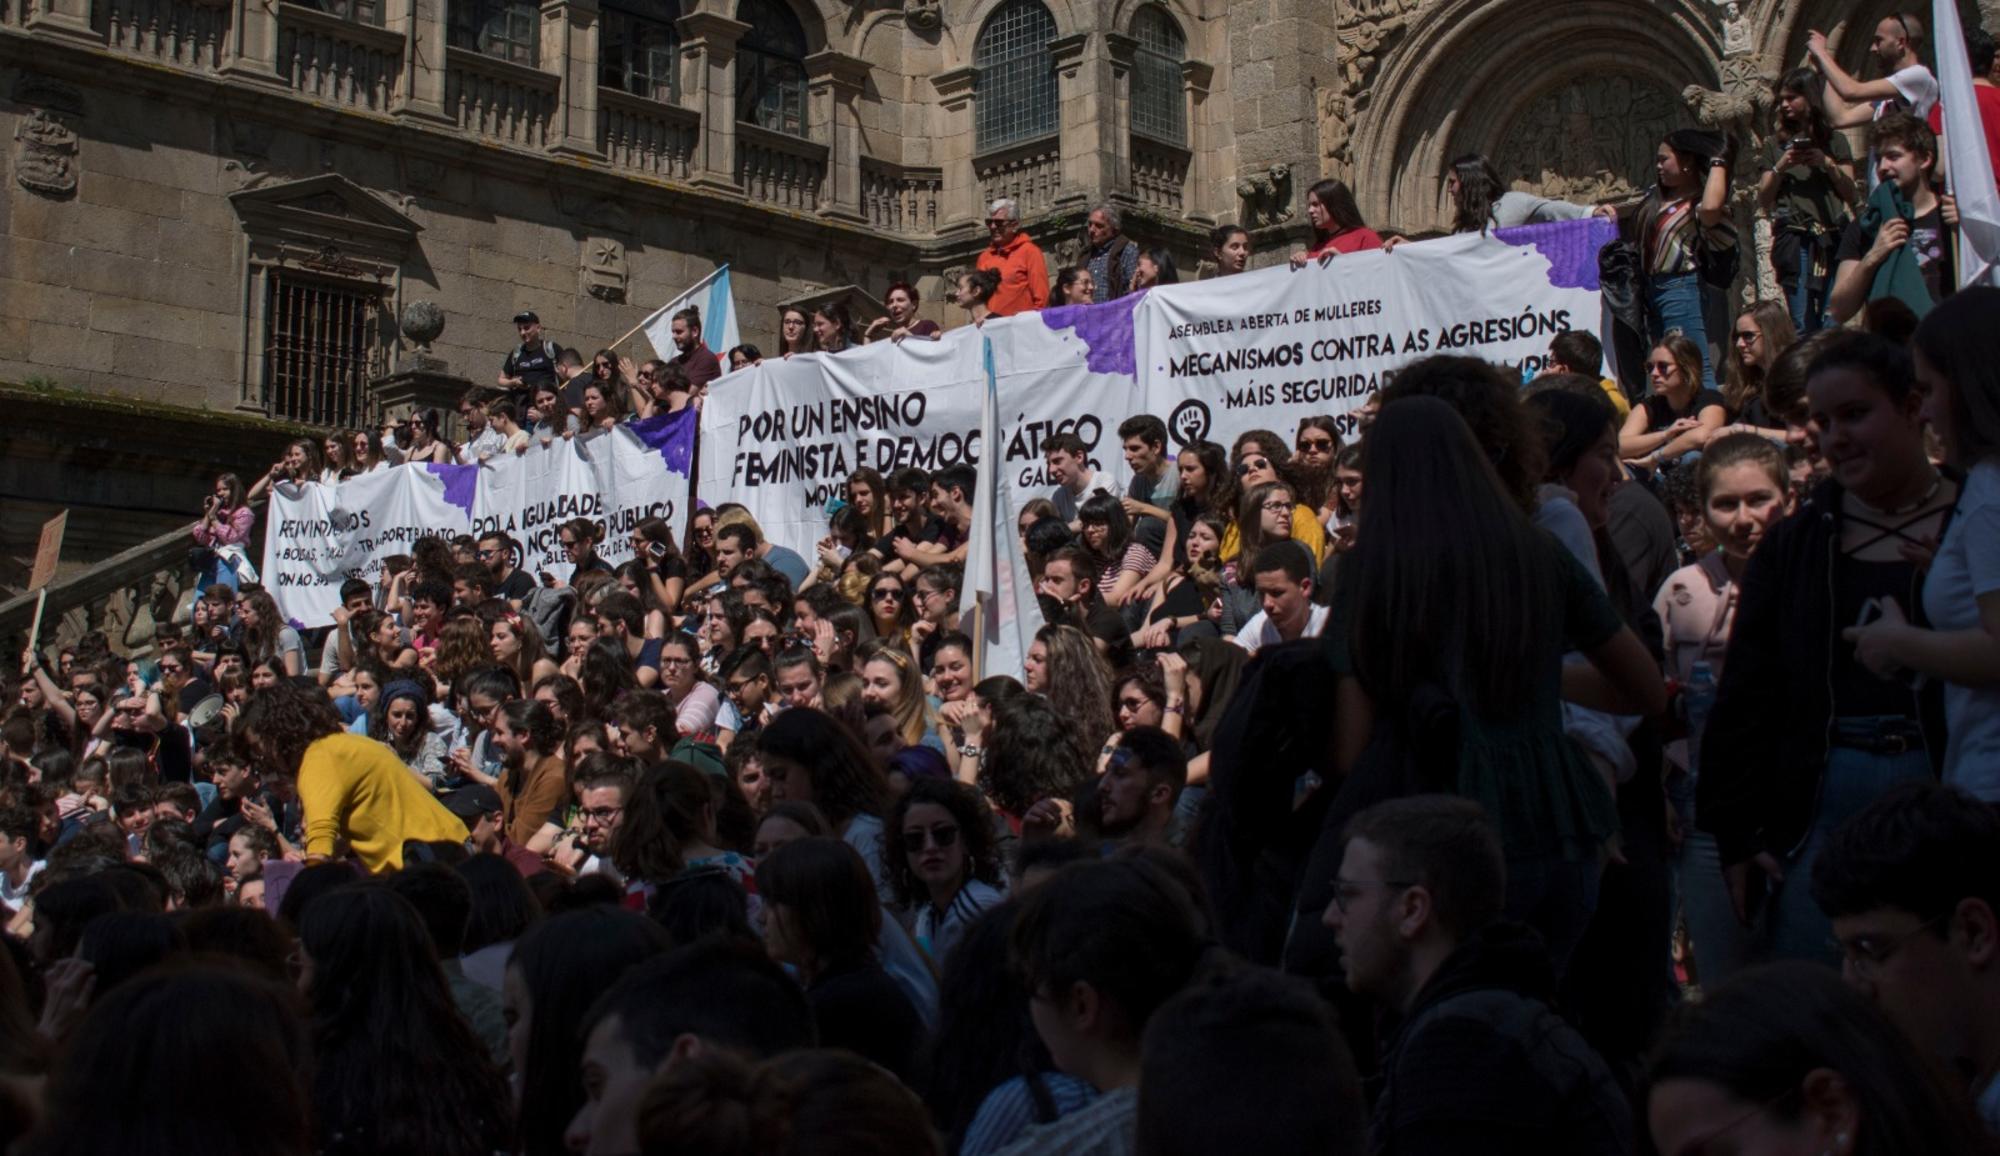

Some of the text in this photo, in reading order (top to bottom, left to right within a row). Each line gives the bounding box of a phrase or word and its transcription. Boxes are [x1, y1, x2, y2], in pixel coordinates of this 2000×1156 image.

[1169, 299, 1382, 340] ASEMBLEA ABERTA DE MULLERES
[1170, 304, 1571, 378] MECANISMOS CONTRA AS AGRESIÓNS
[1226, 379, 1275, 409] MÁIS
[737, 391, 926, 446] POR UN ENSINO
[731, 413, 1102, 487] FEMINISTA E DEMOCÁTICO
[473, 515, 516, 538] POLA
[296, 572, 312, 586] AO
